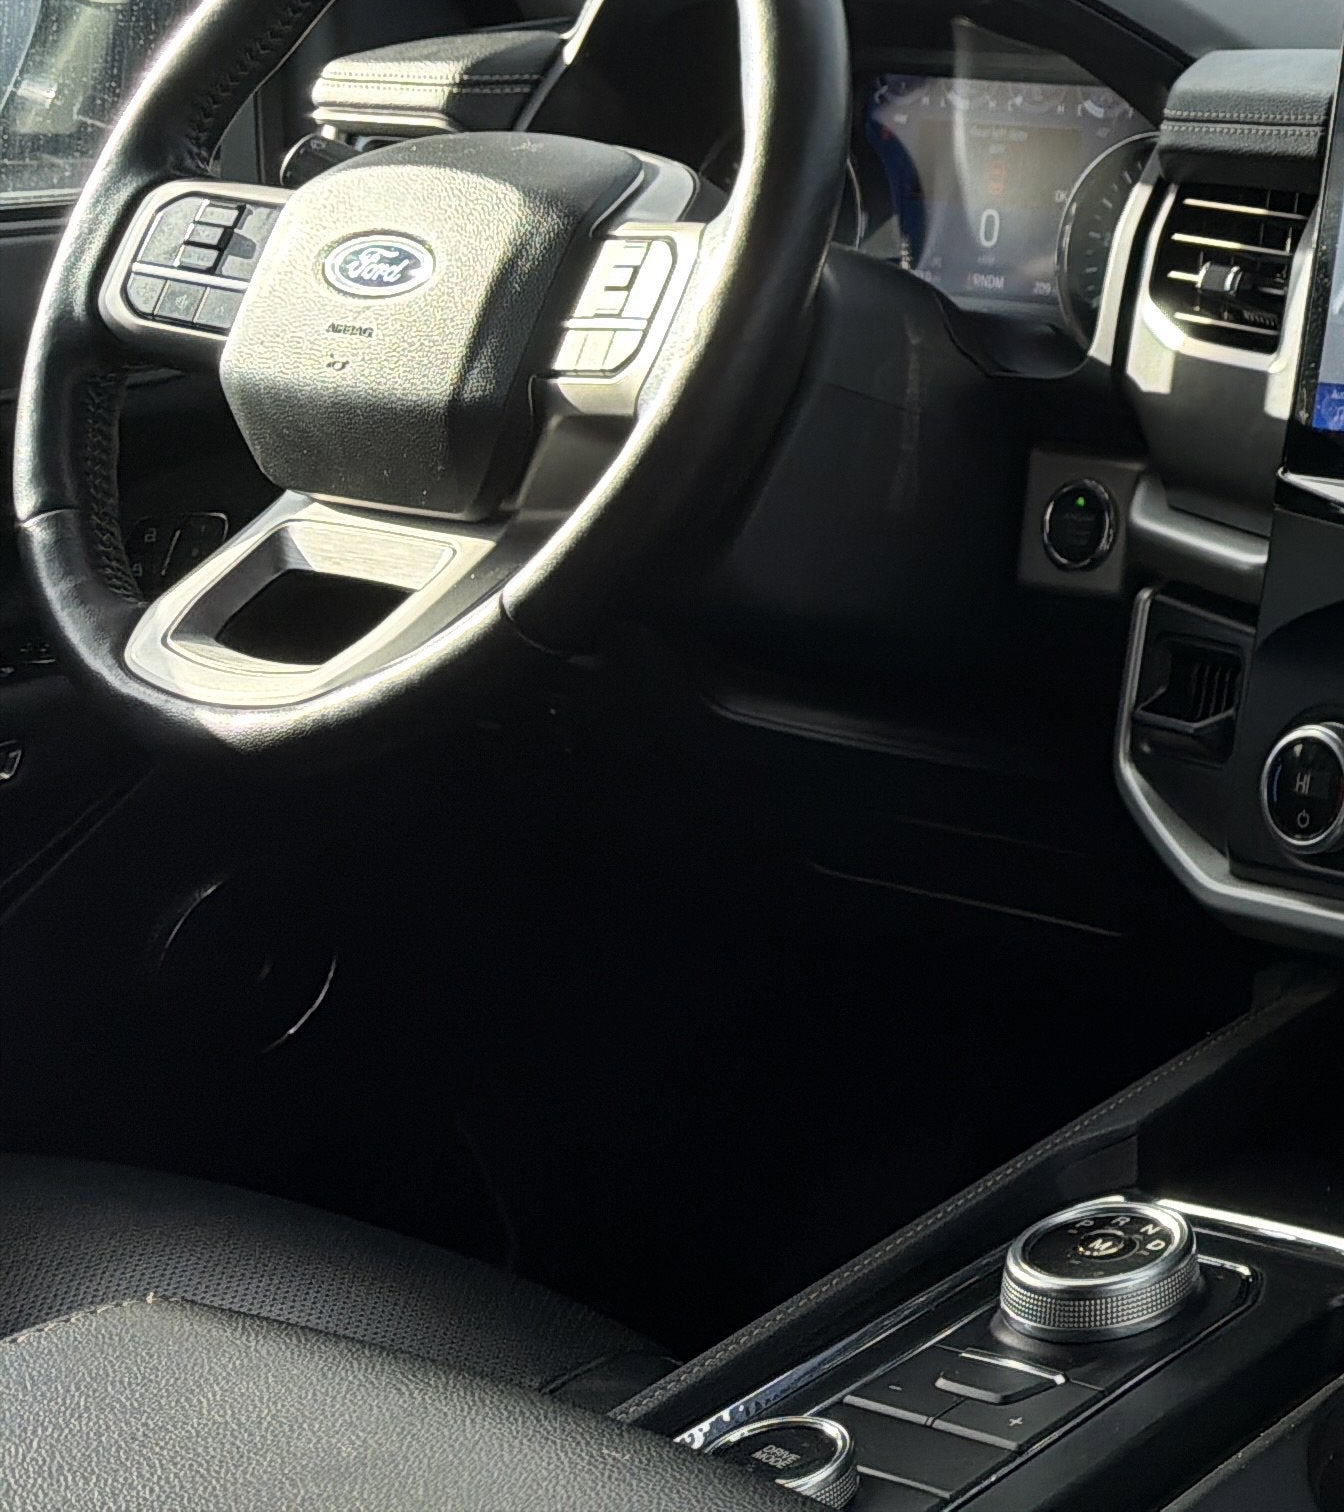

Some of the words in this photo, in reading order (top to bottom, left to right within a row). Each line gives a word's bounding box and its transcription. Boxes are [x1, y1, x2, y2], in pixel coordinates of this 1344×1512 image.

[979, 208, 1001, 248] 0
[346, 247, 410, 283] Ford
[1295, 770, 1311, 795] HI
[1075, 1219, 1094, 1228] P
[1111, 1216, 1131, 1226] R
[1140, 1224, 1163, 1235] N
[1146, 1239, 1166, 1251] D
[762, 1444, 801, 1462] DRIVE
